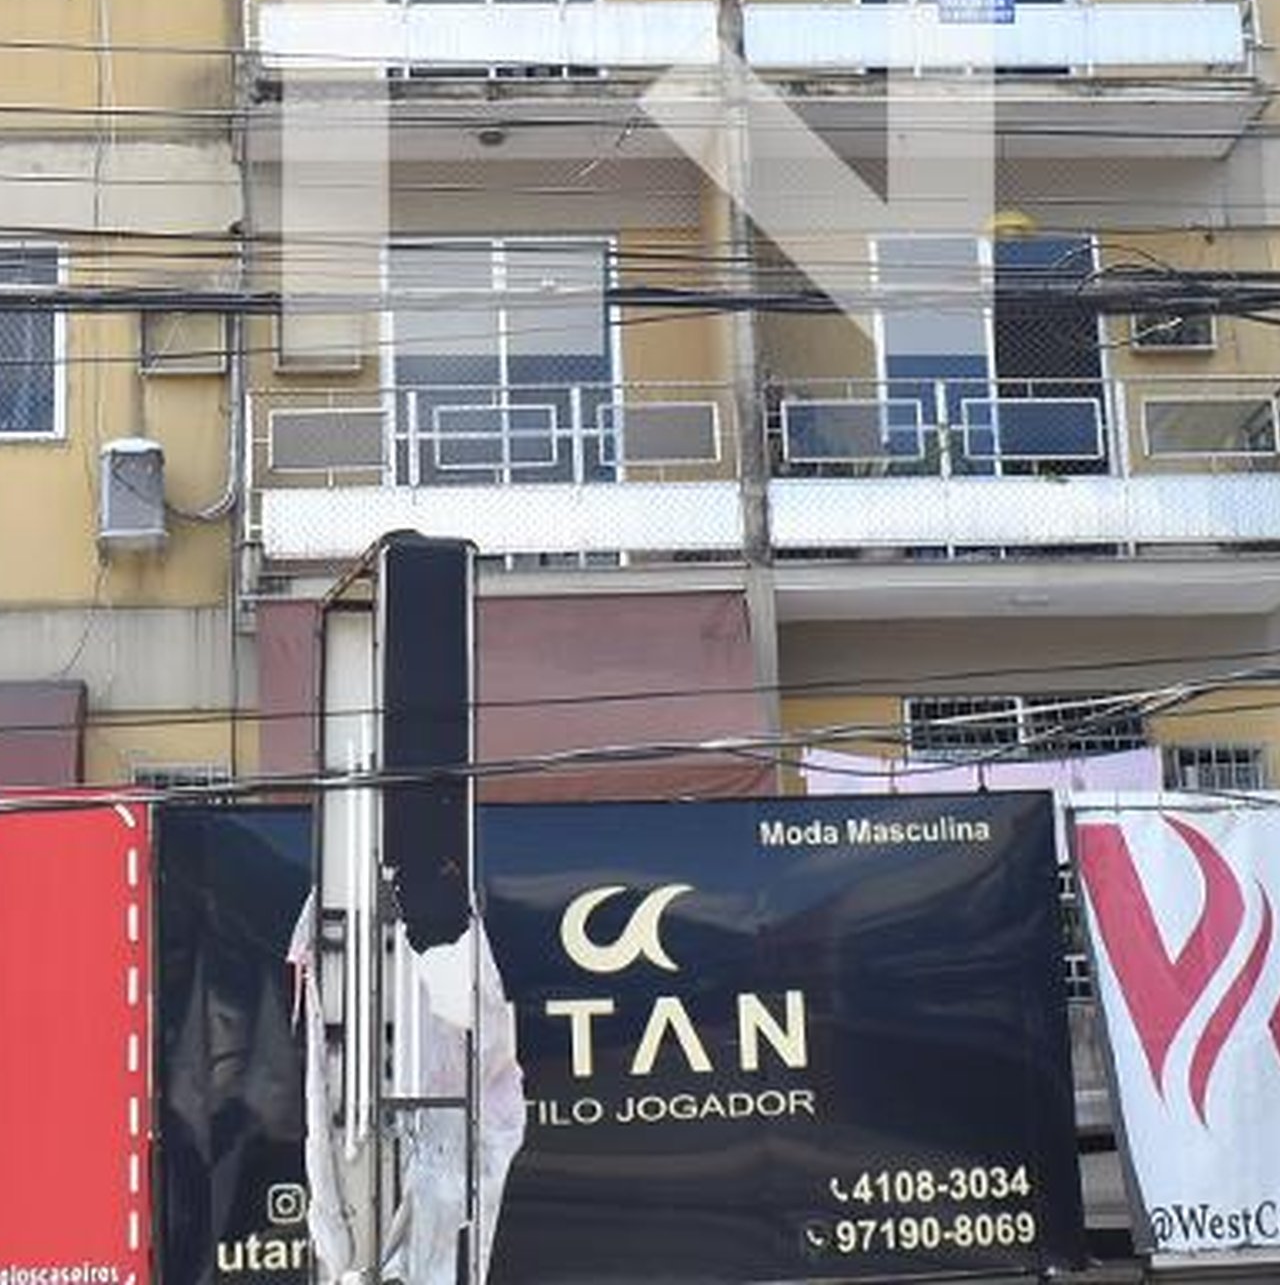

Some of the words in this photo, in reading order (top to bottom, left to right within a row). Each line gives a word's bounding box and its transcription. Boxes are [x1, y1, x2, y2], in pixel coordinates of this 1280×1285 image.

[759, 820, 838, 846] Moda
[846, 816, 991, 844] Masculina
[616, 1090, 816, 1122] JOGADOR
[853, 1166, 1031, 1203] 4108-3034
[836, 1212, 1036, 1252] 97190-8069
